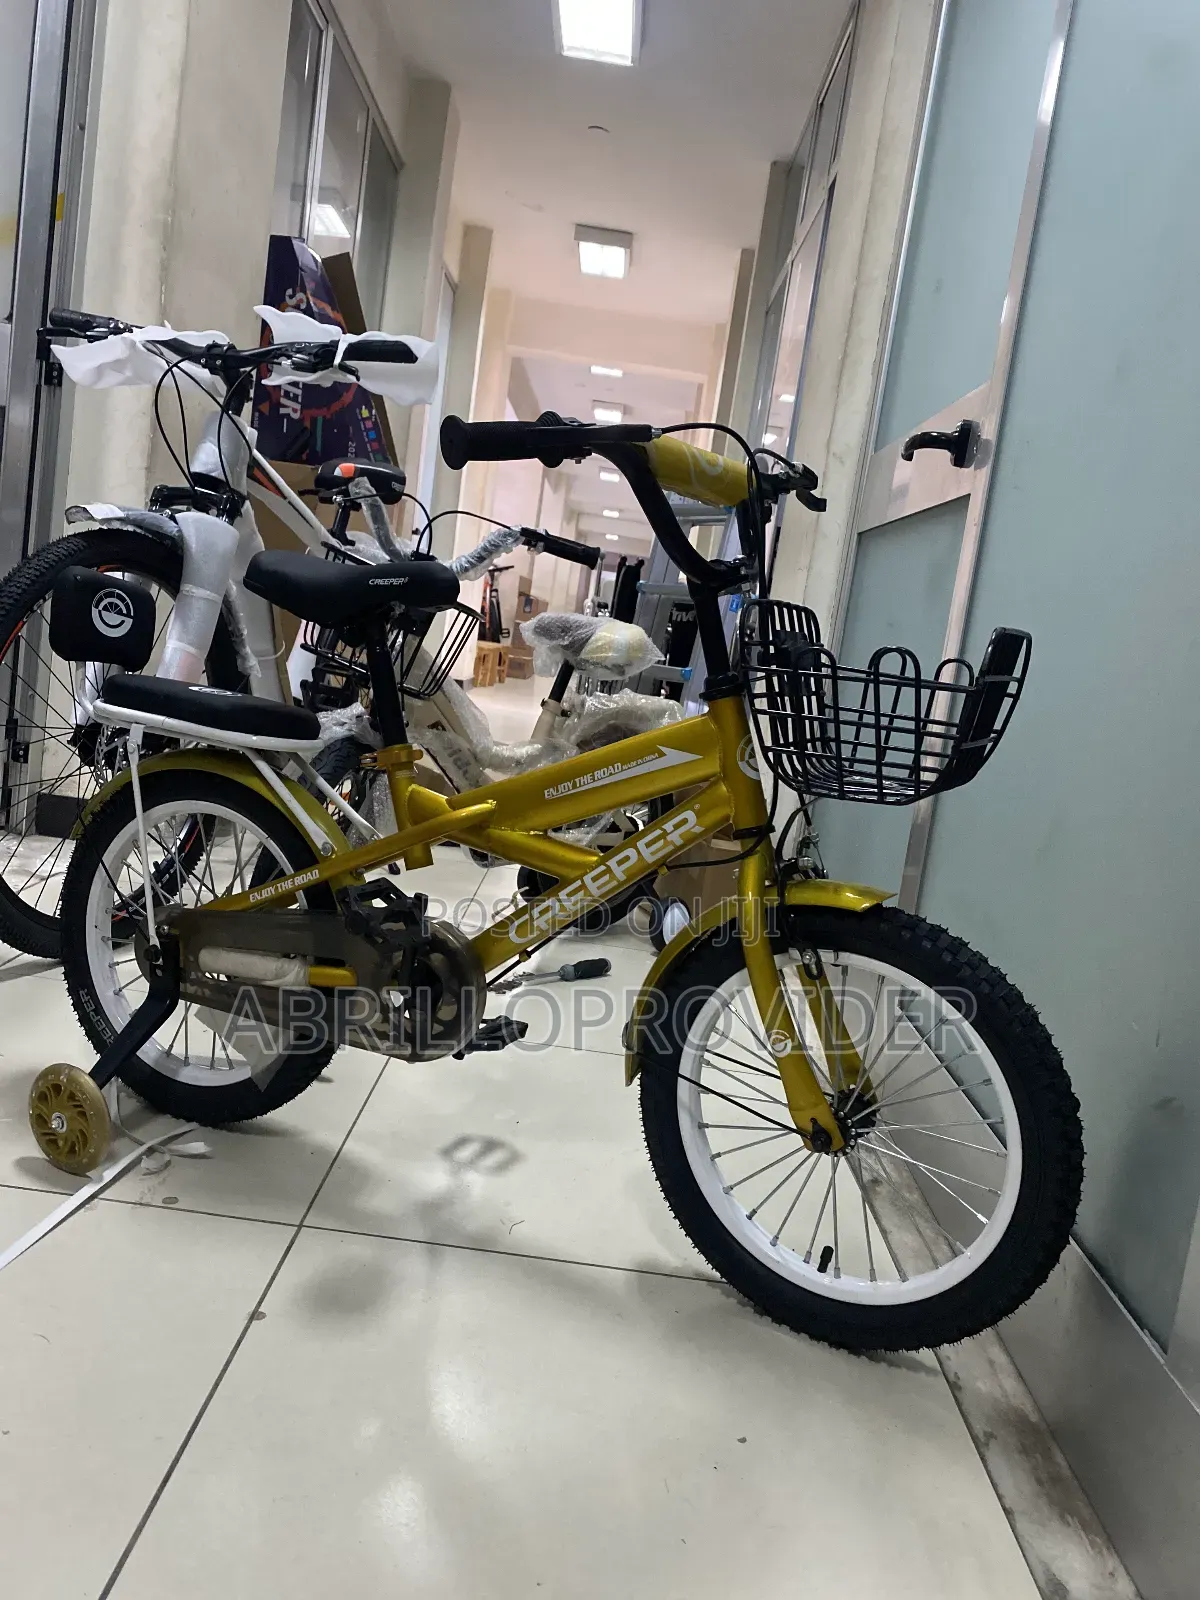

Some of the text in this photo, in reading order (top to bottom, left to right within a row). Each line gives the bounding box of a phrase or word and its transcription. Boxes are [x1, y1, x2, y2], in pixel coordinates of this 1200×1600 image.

[544, 780, 573, 800] ENJOY
[575, 773, 594, 787] THE
[594, 762, 622, 781] ROAD
[249, 869, 320, 903] ENJOY THE ROAD
